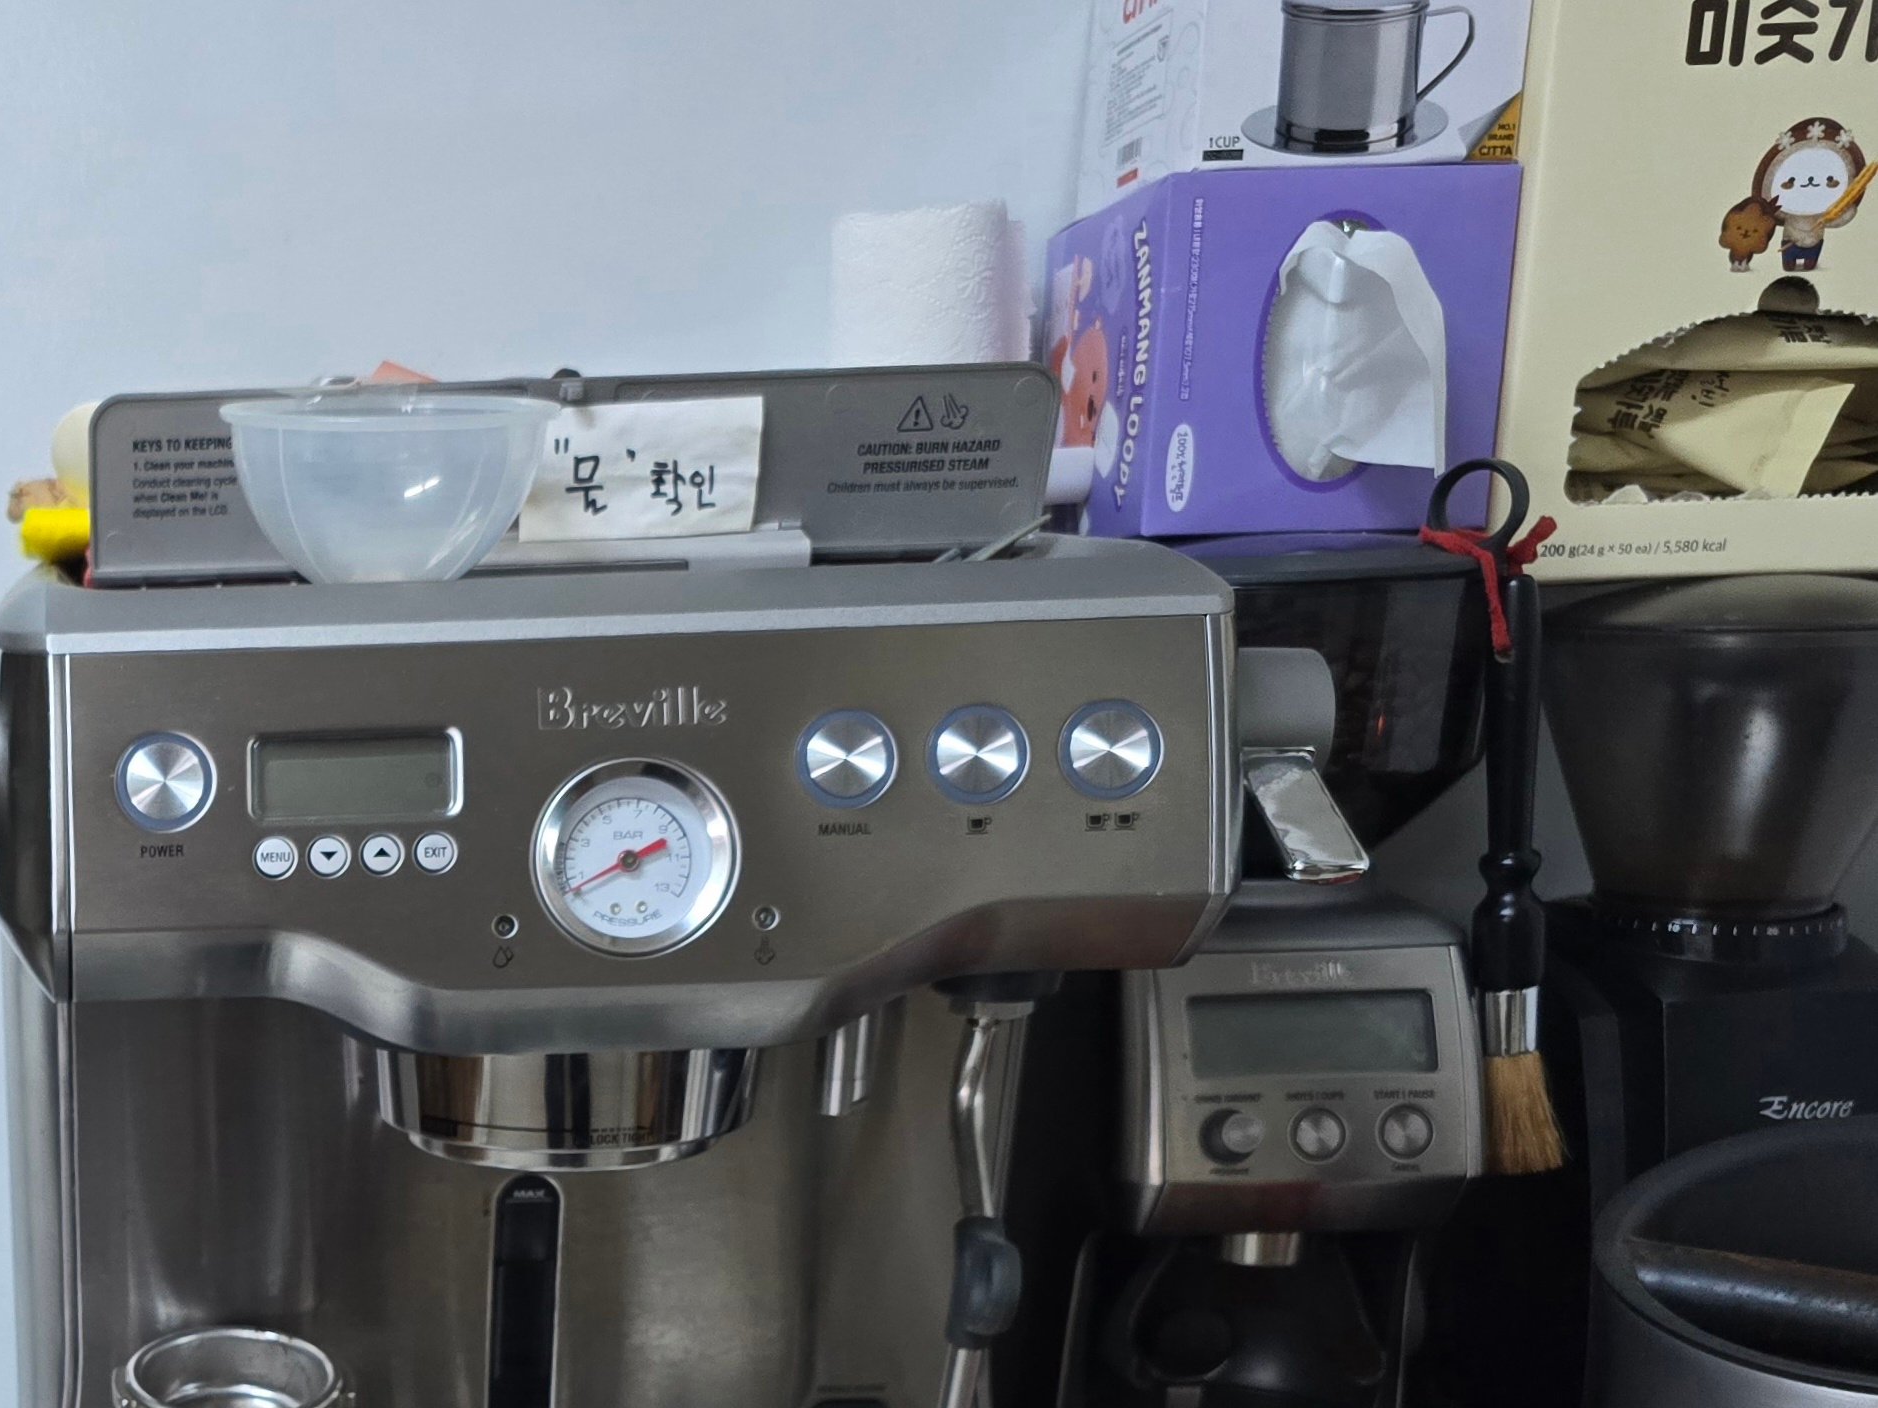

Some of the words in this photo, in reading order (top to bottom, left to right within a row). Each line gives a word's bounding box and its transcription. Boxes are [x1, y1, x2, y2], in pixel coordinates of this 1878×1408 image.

[1133, 219, 1153, 387] ZANMANG
[132, 438, 163, 453] KEYS
[166, 438, 181, 452] TO
[857, 441, 913, 457] CAUTION:
[915, 440, 949, 455] BURN
[951, 439, 1002, 453] HAZARD
[143, 461, 171, 472] Clean
[173, 461, 195, 473] your
[197, 459, 235, 469] machin
[862, 459, 945, 475] PRESSURISED
[947, 457, 990, 472] STEAM
[650, 459, 716, 516] 확인
[827, 480, 872, 494] Children
[873, 480, 902, 493] must
[903, 477, 942, 494] always
[943, 478, 956, 490] be
[958, 476, 1020, 492] supervised.
[161, 492, 187, 502] Clean
[1618, 542, 1633, 555] 50
[1663, 540, 1699, 555] 5,580
[1702, 537, 1727, 553] kcal
[537, 686, 727, 730] Breville
[633, 809, 643, 819] 7
[613, 830, 643, 840] BAR
[658, 824, 668, 834] 9
[817, 822, 872, 836] MANUAL
[581, 838, 590, 848] 3
[140, 844, 185, 859] POWER
[260, 851, 291, 863] MENU
[423, 846, 447, 859] EXIT
[654, 882, 670, 892] 13
[592, 908, 663, 927] PRESSURE
[1374, 1090, 1401, 1101] START
[1758, 1095, 1854, 1120] Encore
[513, 1189, 546, 1199] MAX
